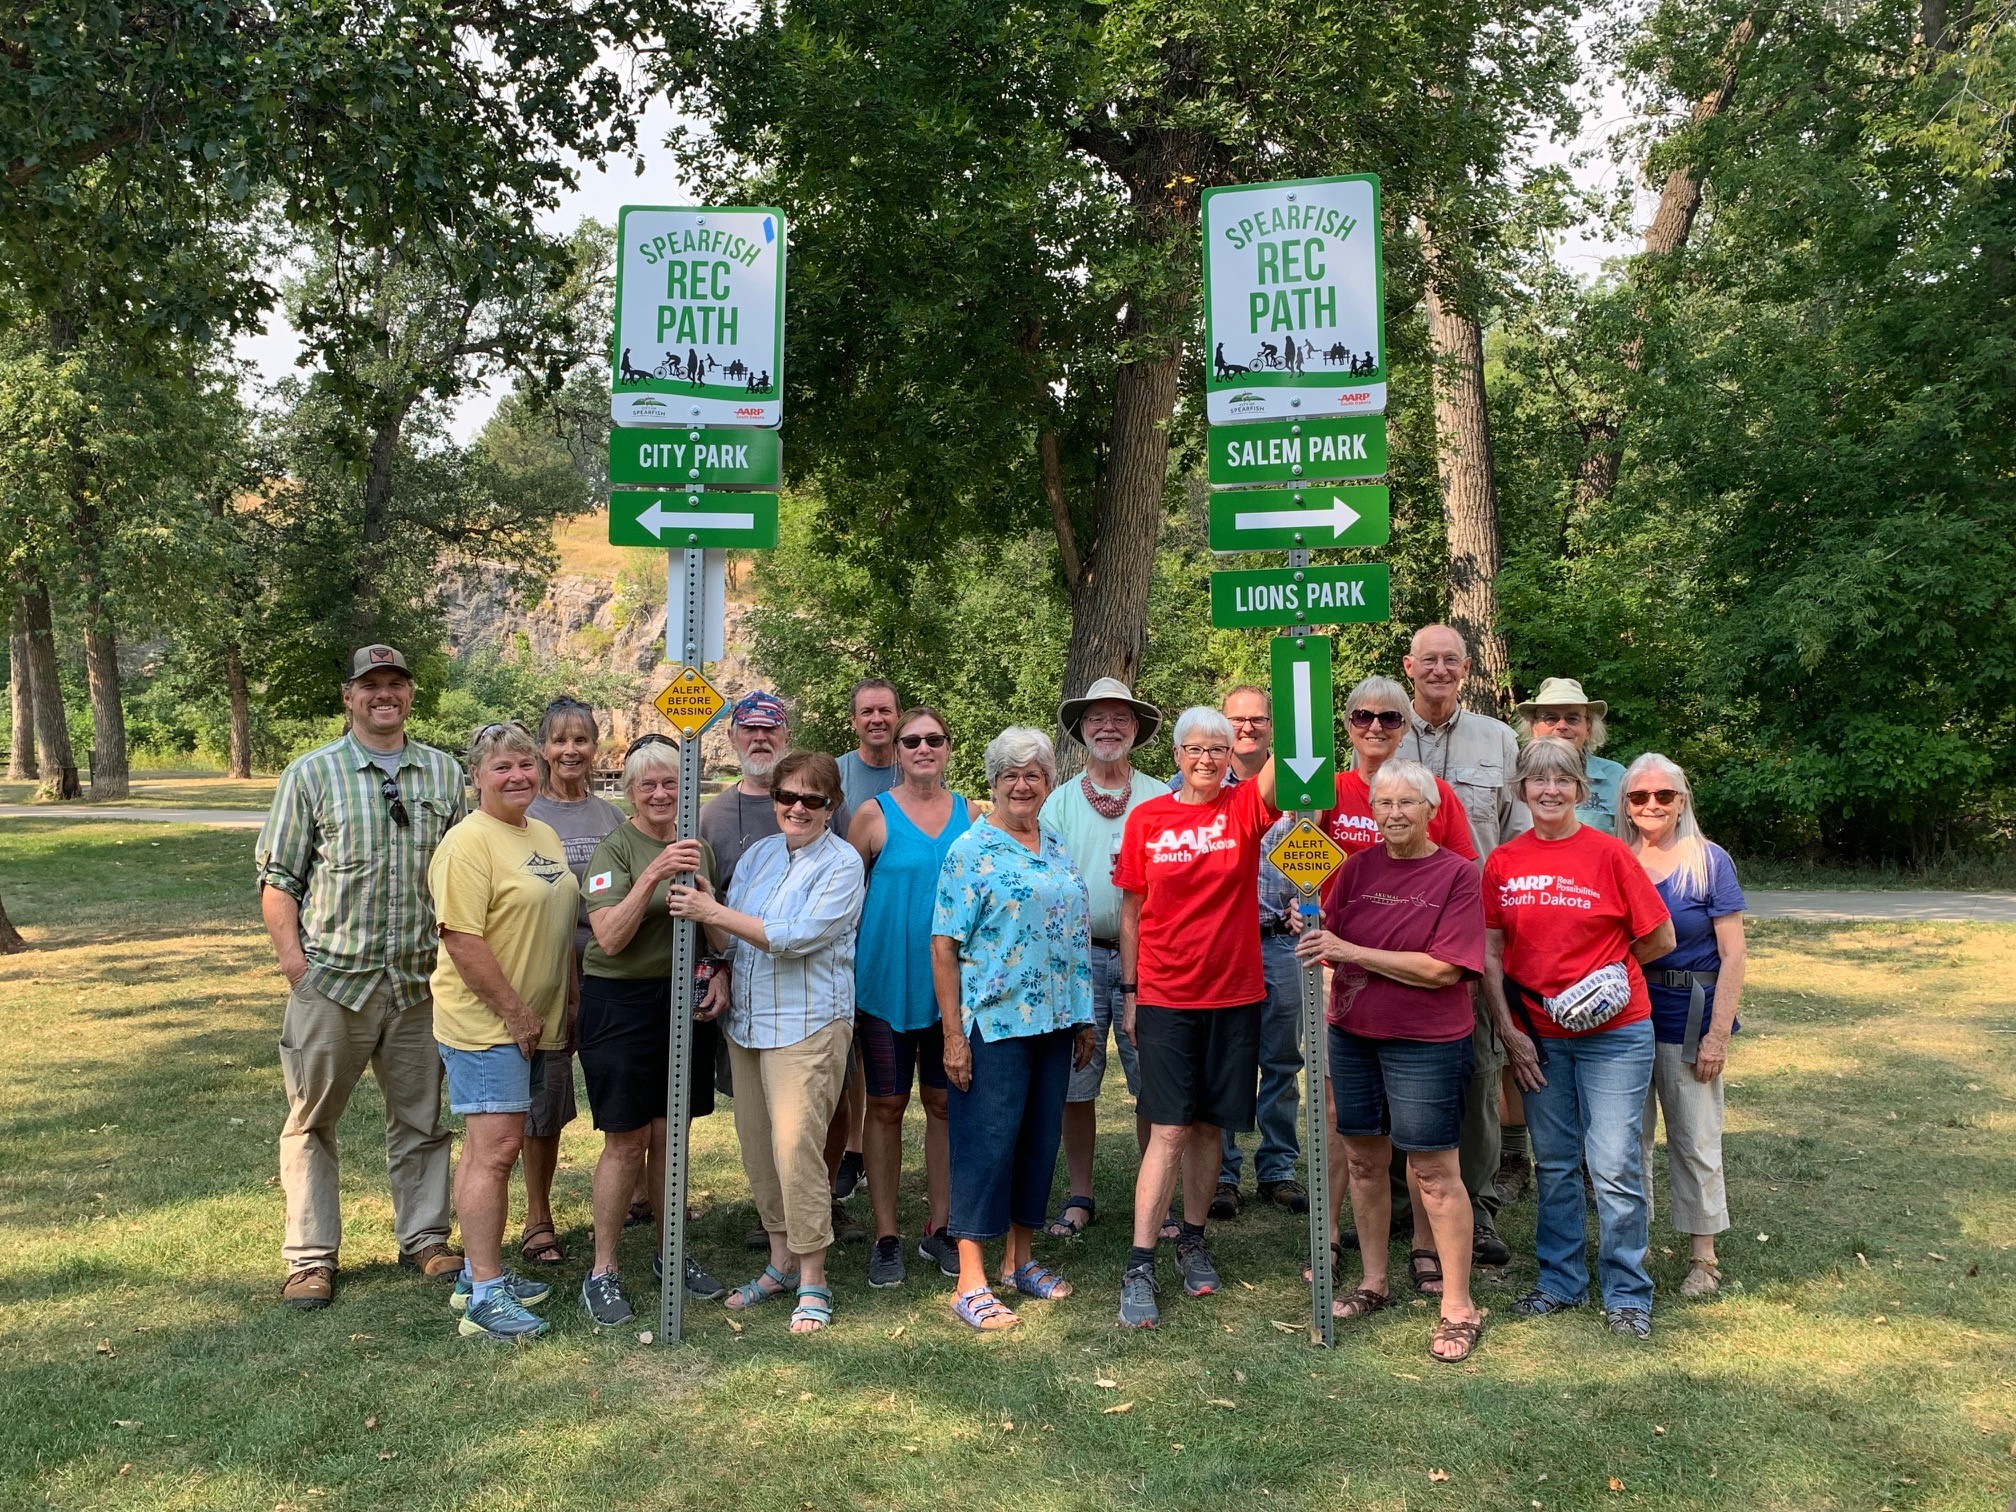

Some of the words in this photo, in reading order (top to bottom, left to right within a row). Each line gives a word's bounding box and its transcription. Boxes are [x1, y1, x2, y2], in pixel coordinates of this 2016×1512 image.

[1225, 205, 1357, 250] SPEARFISH
[638, 229, 762, 267] SPEARFISH
[1257, 237, 1326, 285] REC
[667, 260, 731, 301] REC
[1249, 285, 1337, 334] PATH
[657, 305, 738, 345] PATH
[1337, 393, 1370, 401] AARP
[1230, 406, 1265, 414] SPEARFISH
[639, 444, 687, 468] CITY
[694, 444, 749, 469] PARK
[1227, 438, 1301, 467] SALEM
[1309, 433, 1368, 462] PARK
[1236, 584, 1299, 612] LIONS
[1307, 581, 1366, 608] PARK
[672, 686, 707, 694] ALERT
[668, 697, 711, 705] BEFORE
[666, 707, 713, 715] PASSING
[1333, 828, 1370, 843] South
[1288, 840, 1324, 848] ALERT
[1284, 851, 1329, 860] BEFORE
[1283, 862, 1331, 871] PASSING
[1557, 876, 1575, 885] Real
[1556, 884, 1601, 899] Possibilities
[1501, 891, 1535, 907] South
[1540, 892, 1592, 909] Dakota
